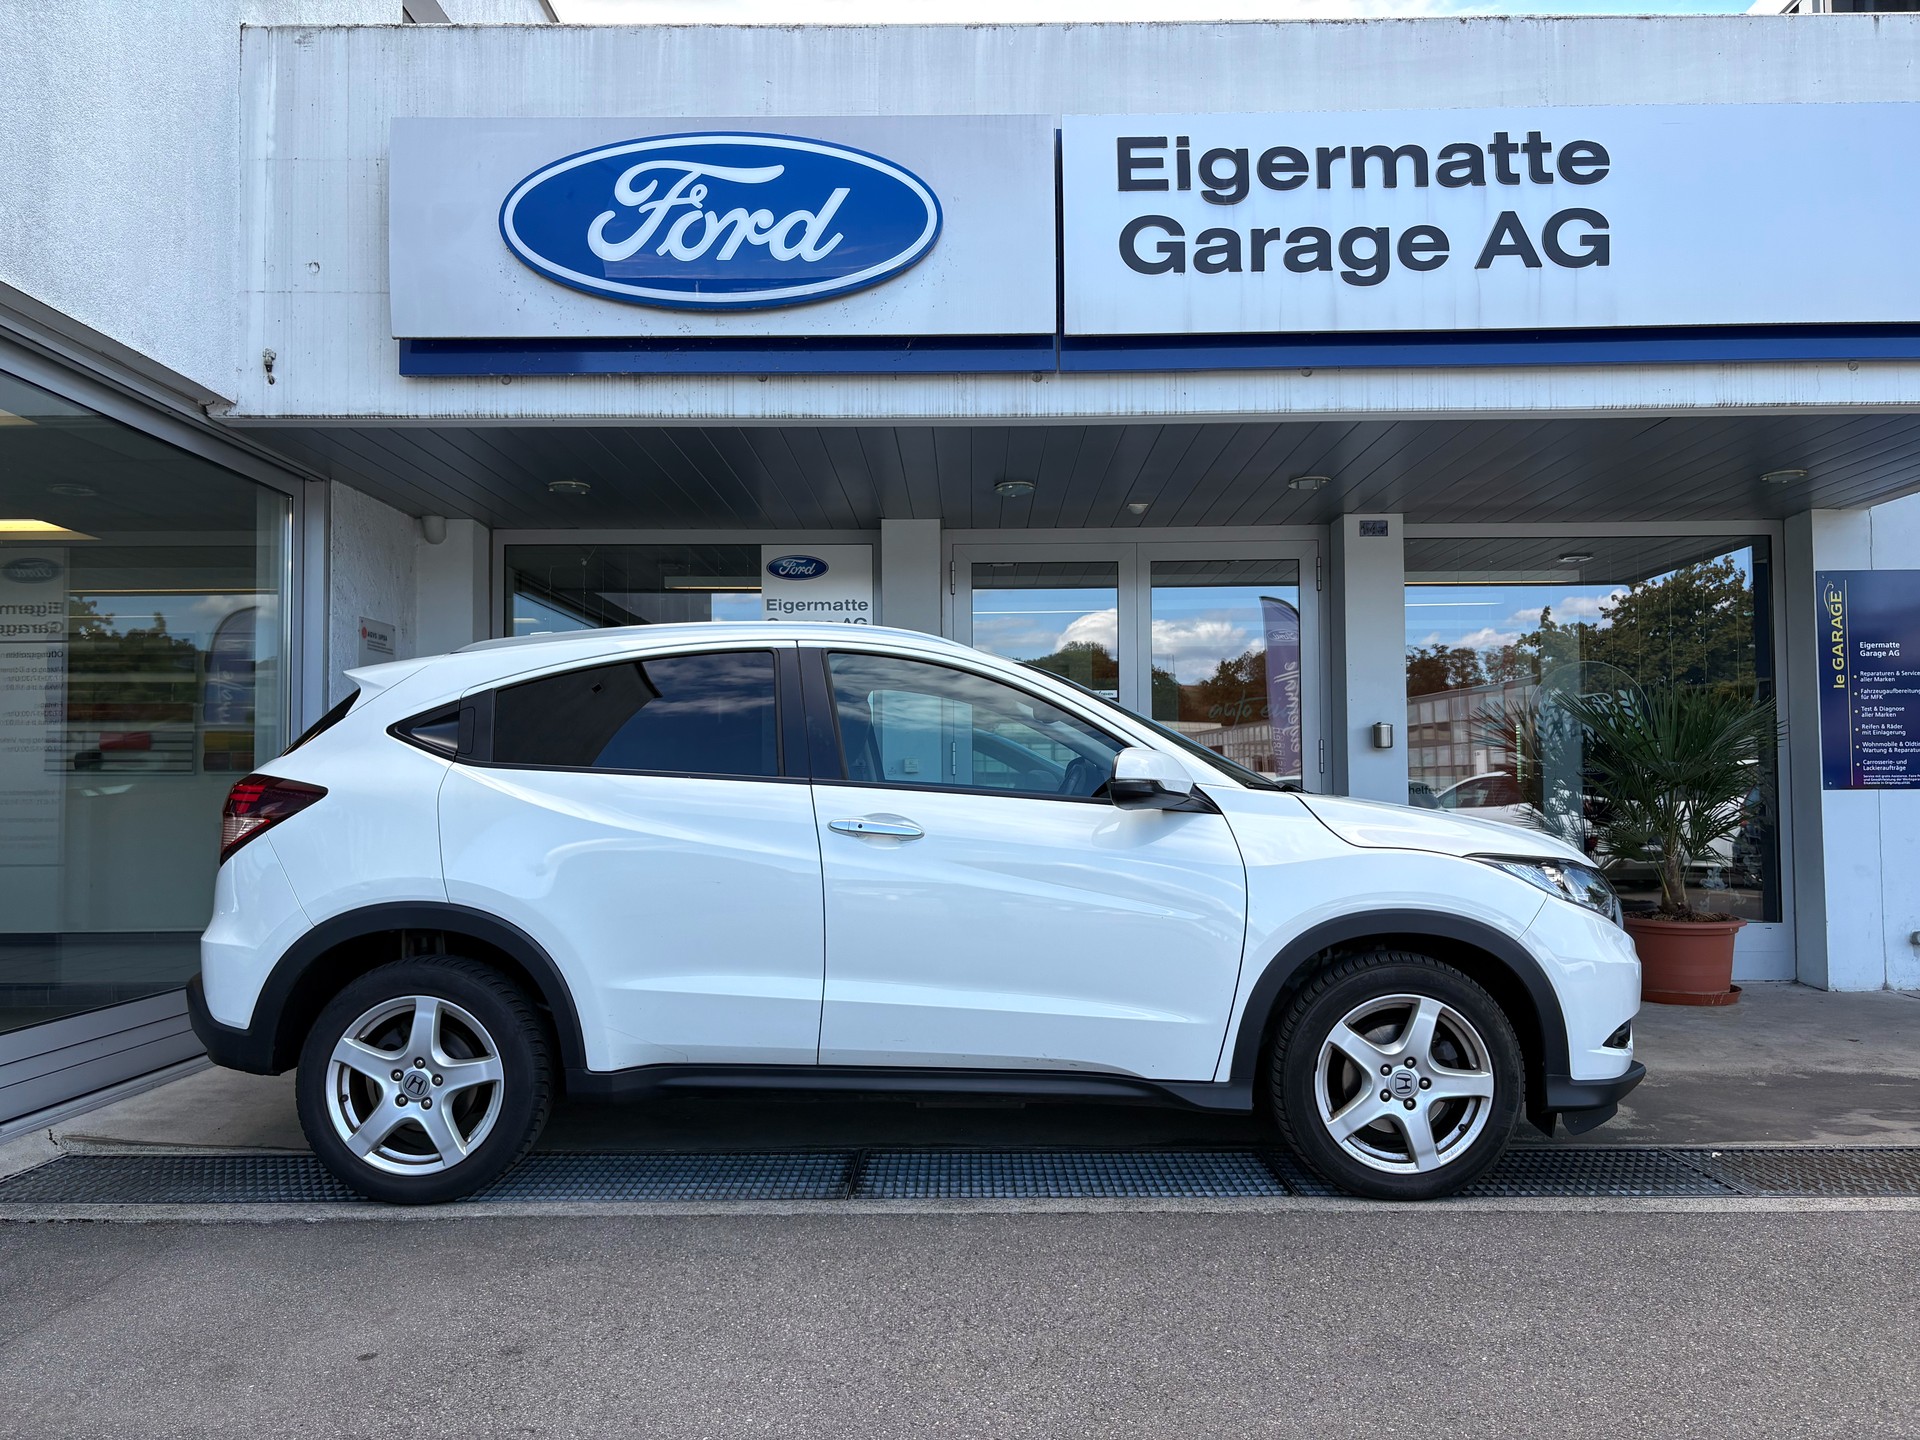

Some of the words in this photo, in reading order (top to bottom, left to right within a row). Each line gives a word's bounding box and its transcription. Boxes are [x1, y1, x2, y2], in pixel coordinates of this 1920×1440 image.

[1116, 131, 1611, 205] Eigermatte
[587, 159, 850, 262] Ford
[1118, 214, 1450, 287] Garage
[1474, 207, 1611, 270] AG
[778, 558, 816, 575] Ford
[766, 598, 868, 614] Eigermatte
[1830, 590, 1845, 670] GARAGE
[1859, 641, 1900, 650] Eigermatte
[1859, 650, 1887, 658] Garage
[1833, 674, 1846, 689] le
